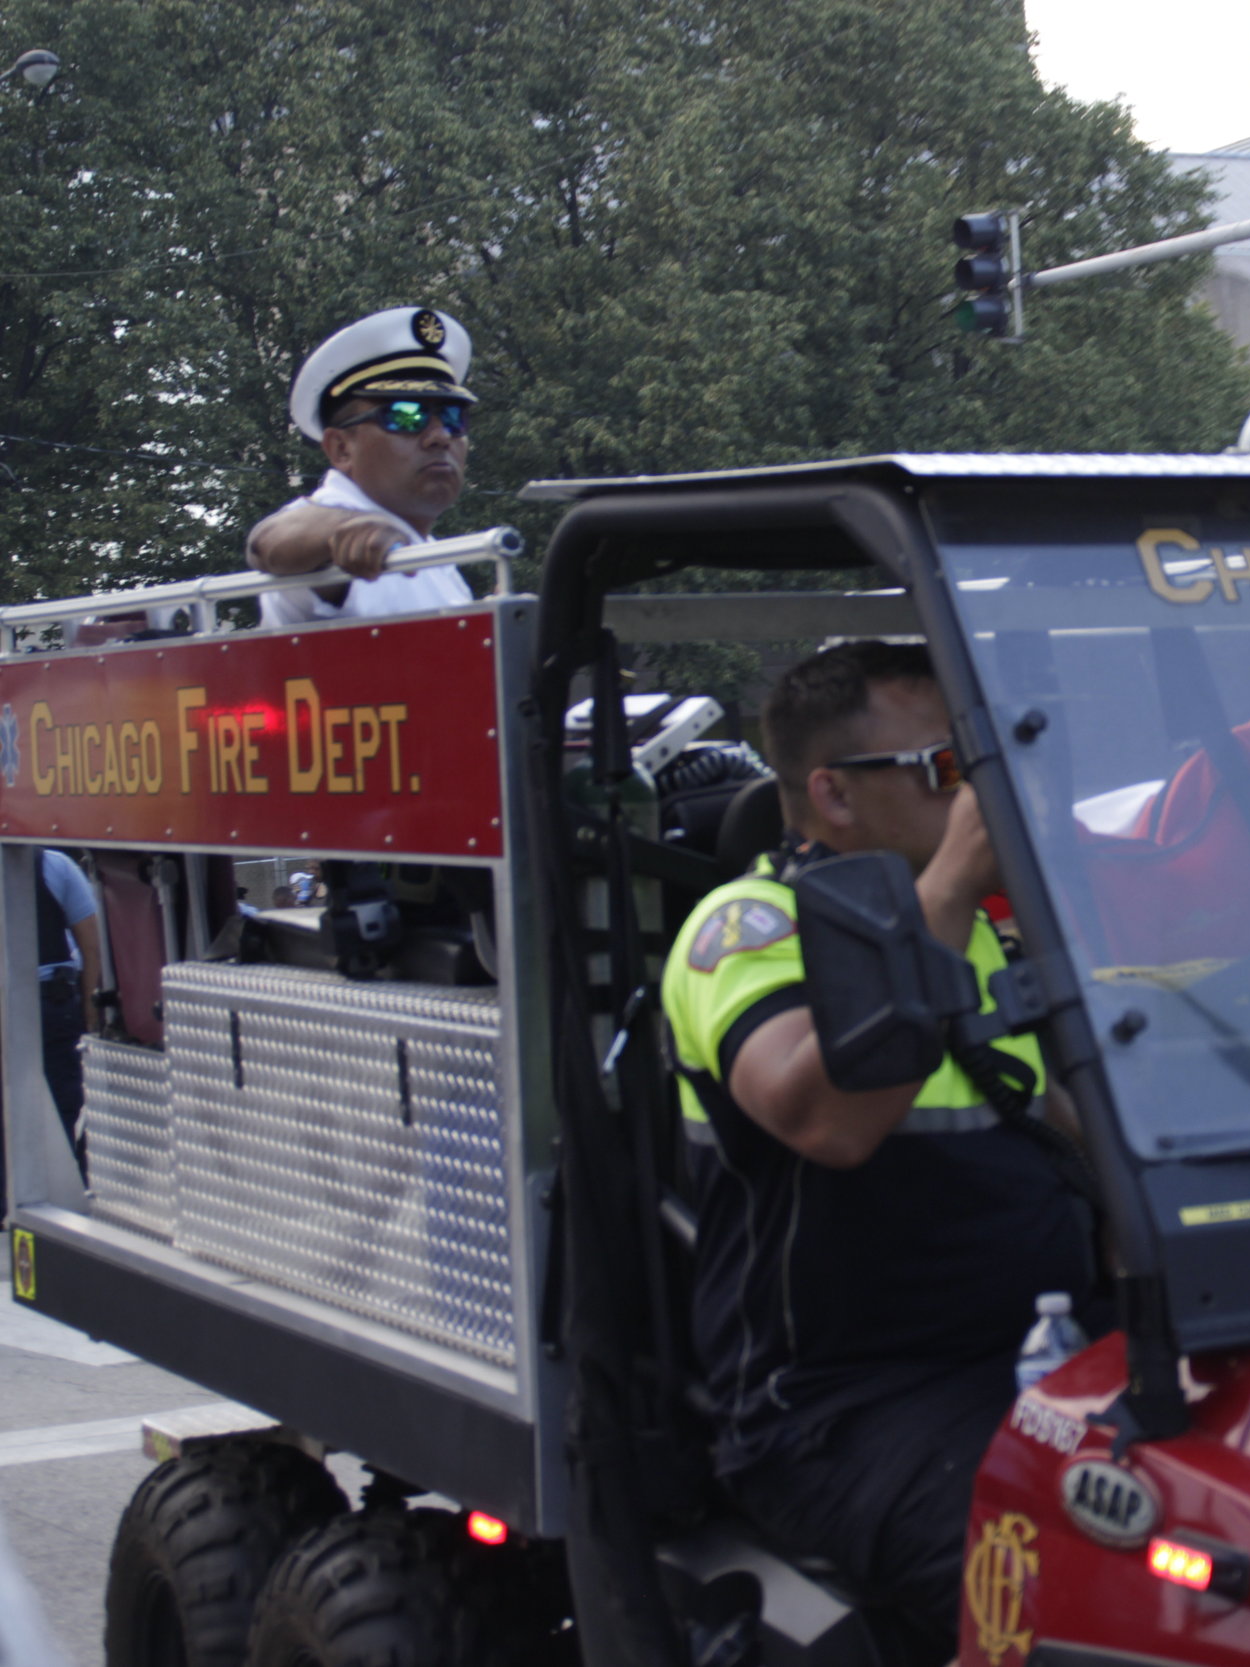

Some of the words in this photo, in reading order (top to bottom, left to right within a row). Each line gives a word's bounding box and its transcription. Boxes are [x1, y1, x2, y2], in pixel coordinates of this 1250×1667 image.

[30, 701, 163, 796] CHICAGO
[177, 685, 270, 794] FIRE
[284, 677, 421, 794] DEPT.
[1073, 1467, 1142, 1529] ASAP
